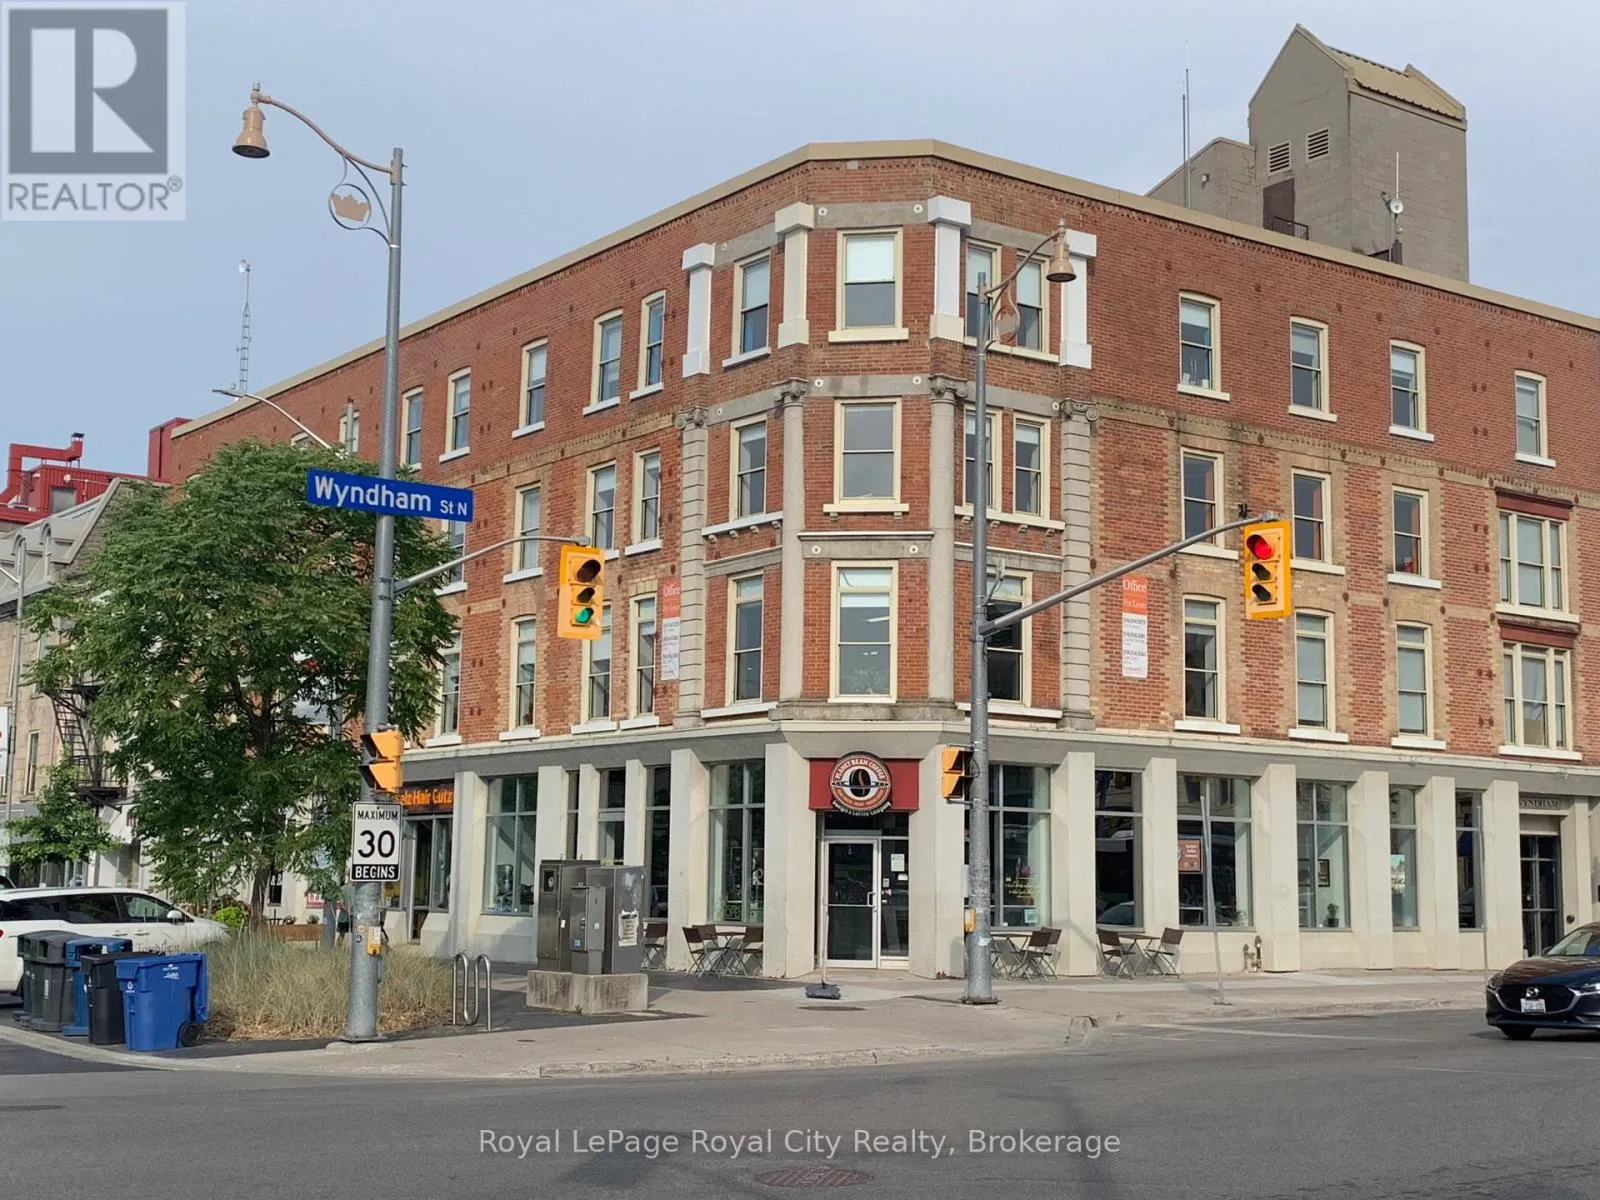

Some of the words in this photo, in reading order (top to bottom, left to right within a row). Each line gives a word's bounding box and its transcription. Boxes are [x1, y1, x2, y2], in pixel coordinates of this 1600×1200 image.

[314, 475, 432, 512] Wyndham
[439, 499, 454, 515] St
[457, 502, 468, 516] N
[413, 789, 431, 805] Hair
[432, 788, 453, 804] Cutz
[1520, 799, 1559, 809] YNDHAM
[358, 811, 398, 821] MAXIMUM
[357, 830, 395, 859] 30
[355, 865, 396, 879] BEGINS
